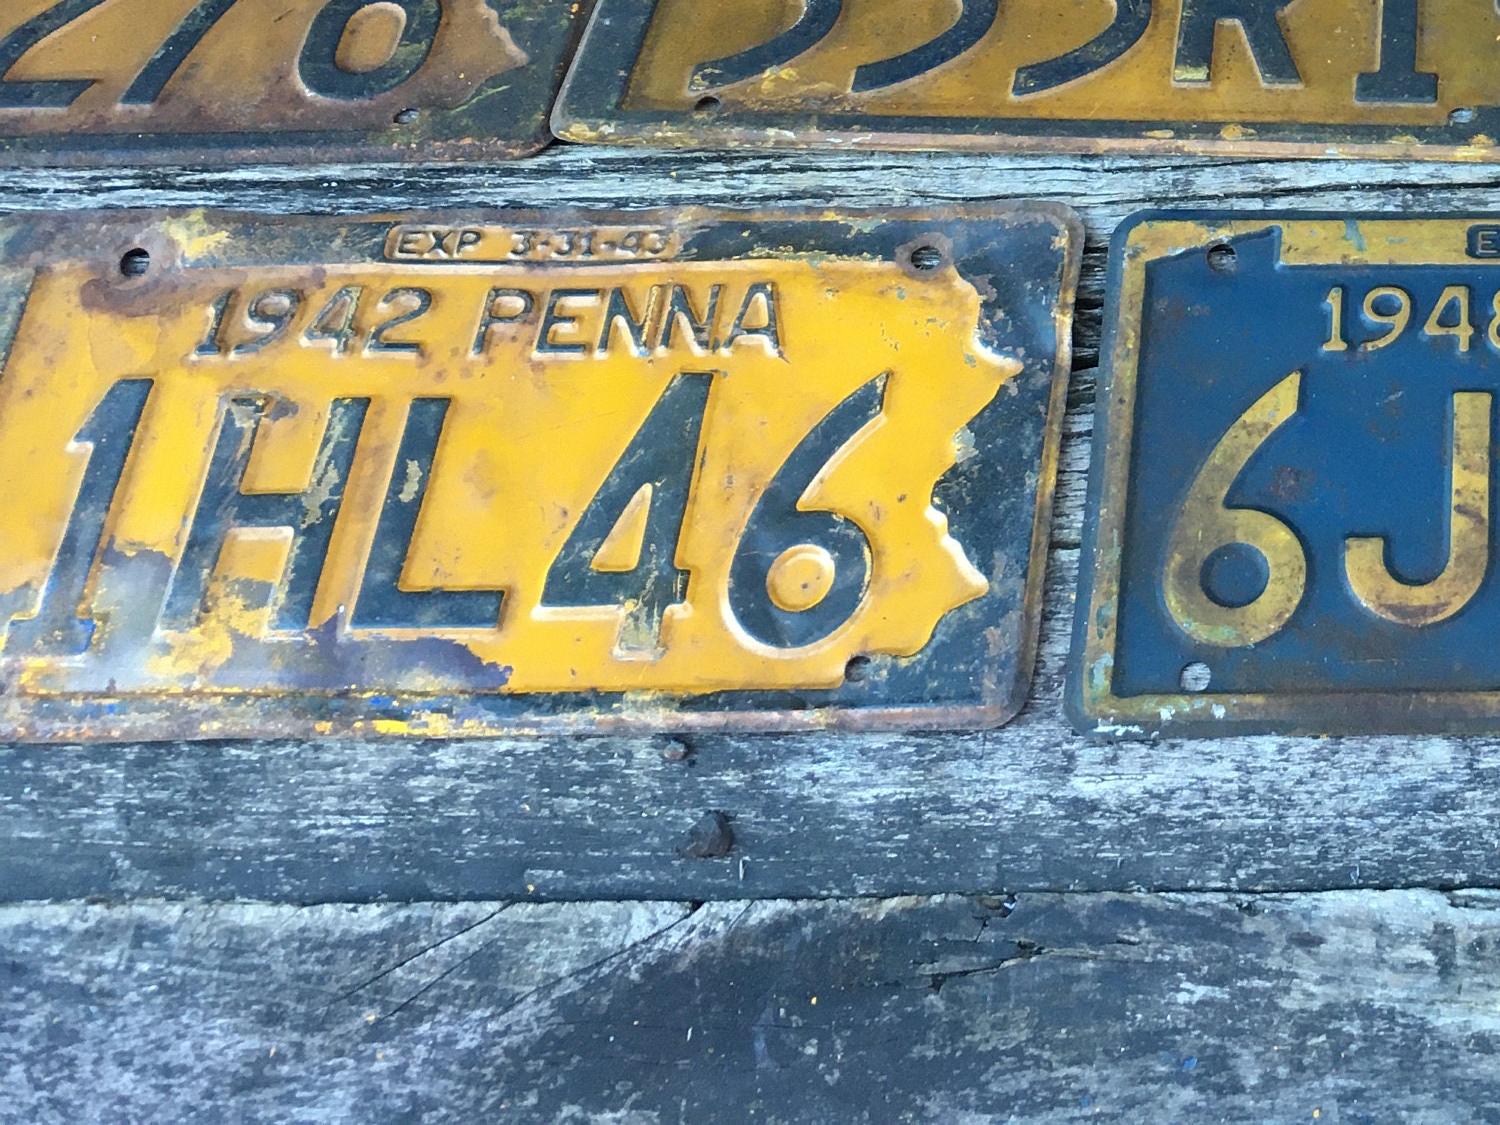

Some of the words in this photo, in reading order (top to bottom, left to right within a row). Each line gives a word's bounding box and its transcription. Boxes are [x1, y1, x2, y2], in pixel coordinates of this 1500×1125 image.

[193, 285, 433, 356] 1942
[470, 280, 785, 359] PENNA
[0, 369, 895, 657] 1HL46
